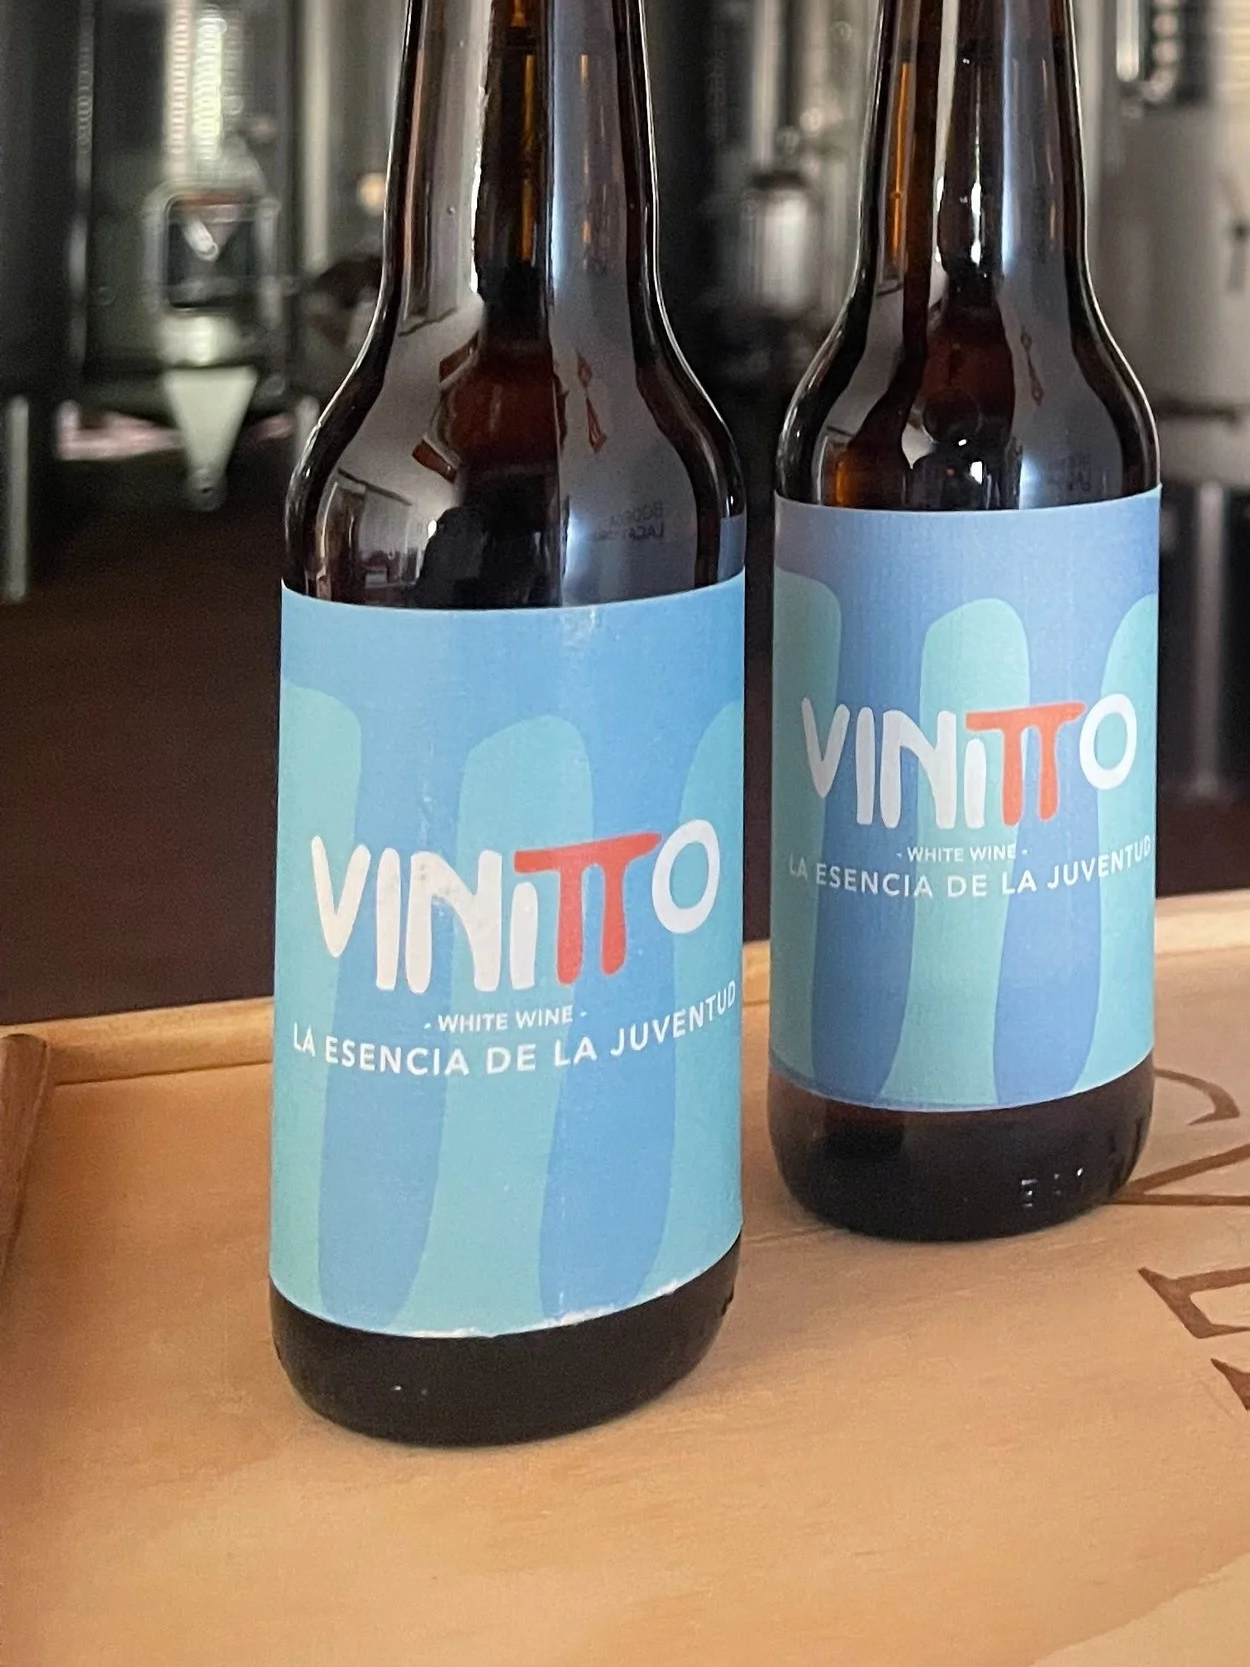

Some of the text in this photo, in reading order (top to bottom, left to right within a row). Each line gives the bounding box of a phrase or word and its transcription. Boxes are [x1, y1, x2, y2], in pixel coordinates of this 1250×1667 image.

[789, 834, 1152, 898] LA ESENCIA DE LA JUVENTUD
[907, 843, 1016, 863] WHITE WINE
[293, 980, 737, 1077] LA ESENCIA DE LA JUVENTUD
[438, 1005, 573, 1034] WHITE WINE
